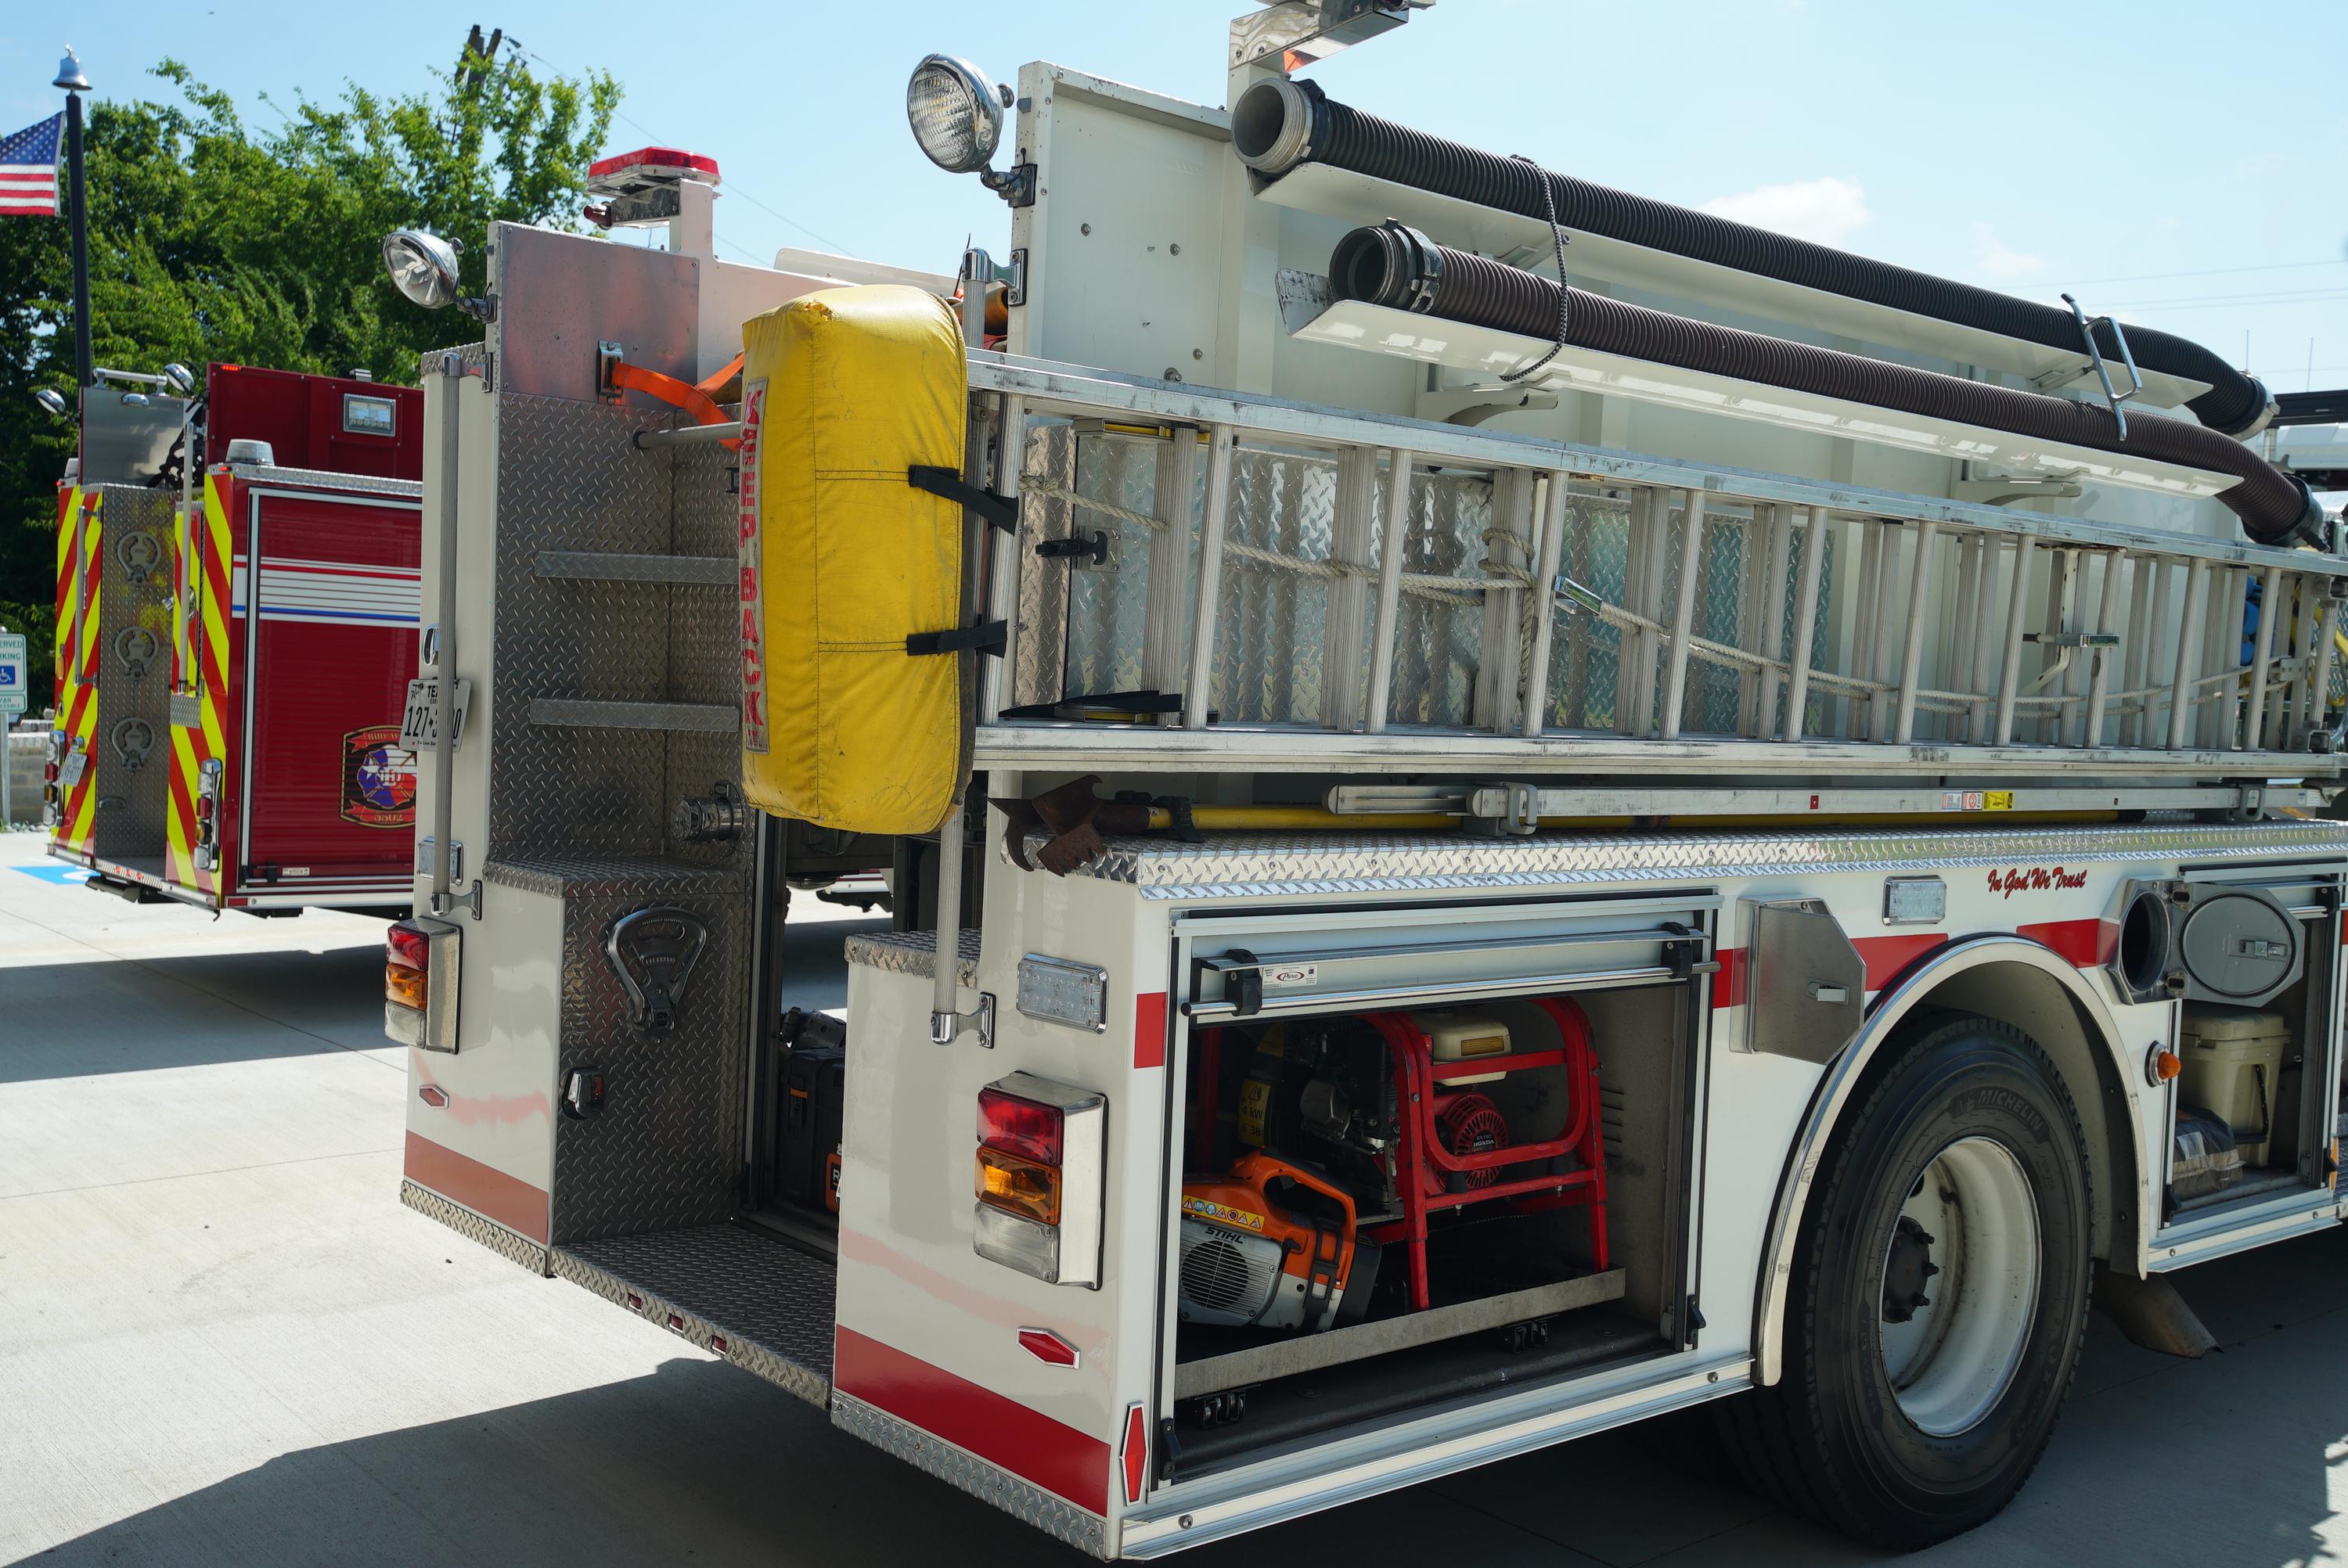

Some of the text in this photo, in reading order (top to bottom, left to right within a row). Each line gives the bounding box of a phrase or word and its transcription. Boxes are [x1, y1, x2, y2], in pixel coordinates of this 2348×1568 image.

[740, 566, 764, 726] BACK
[1987, 866, 2087, 900] In God We Trust
[1978, 1089, 2044, 1131] MICHELIN
[1205, 1226, 1244, 1244] STIHL
